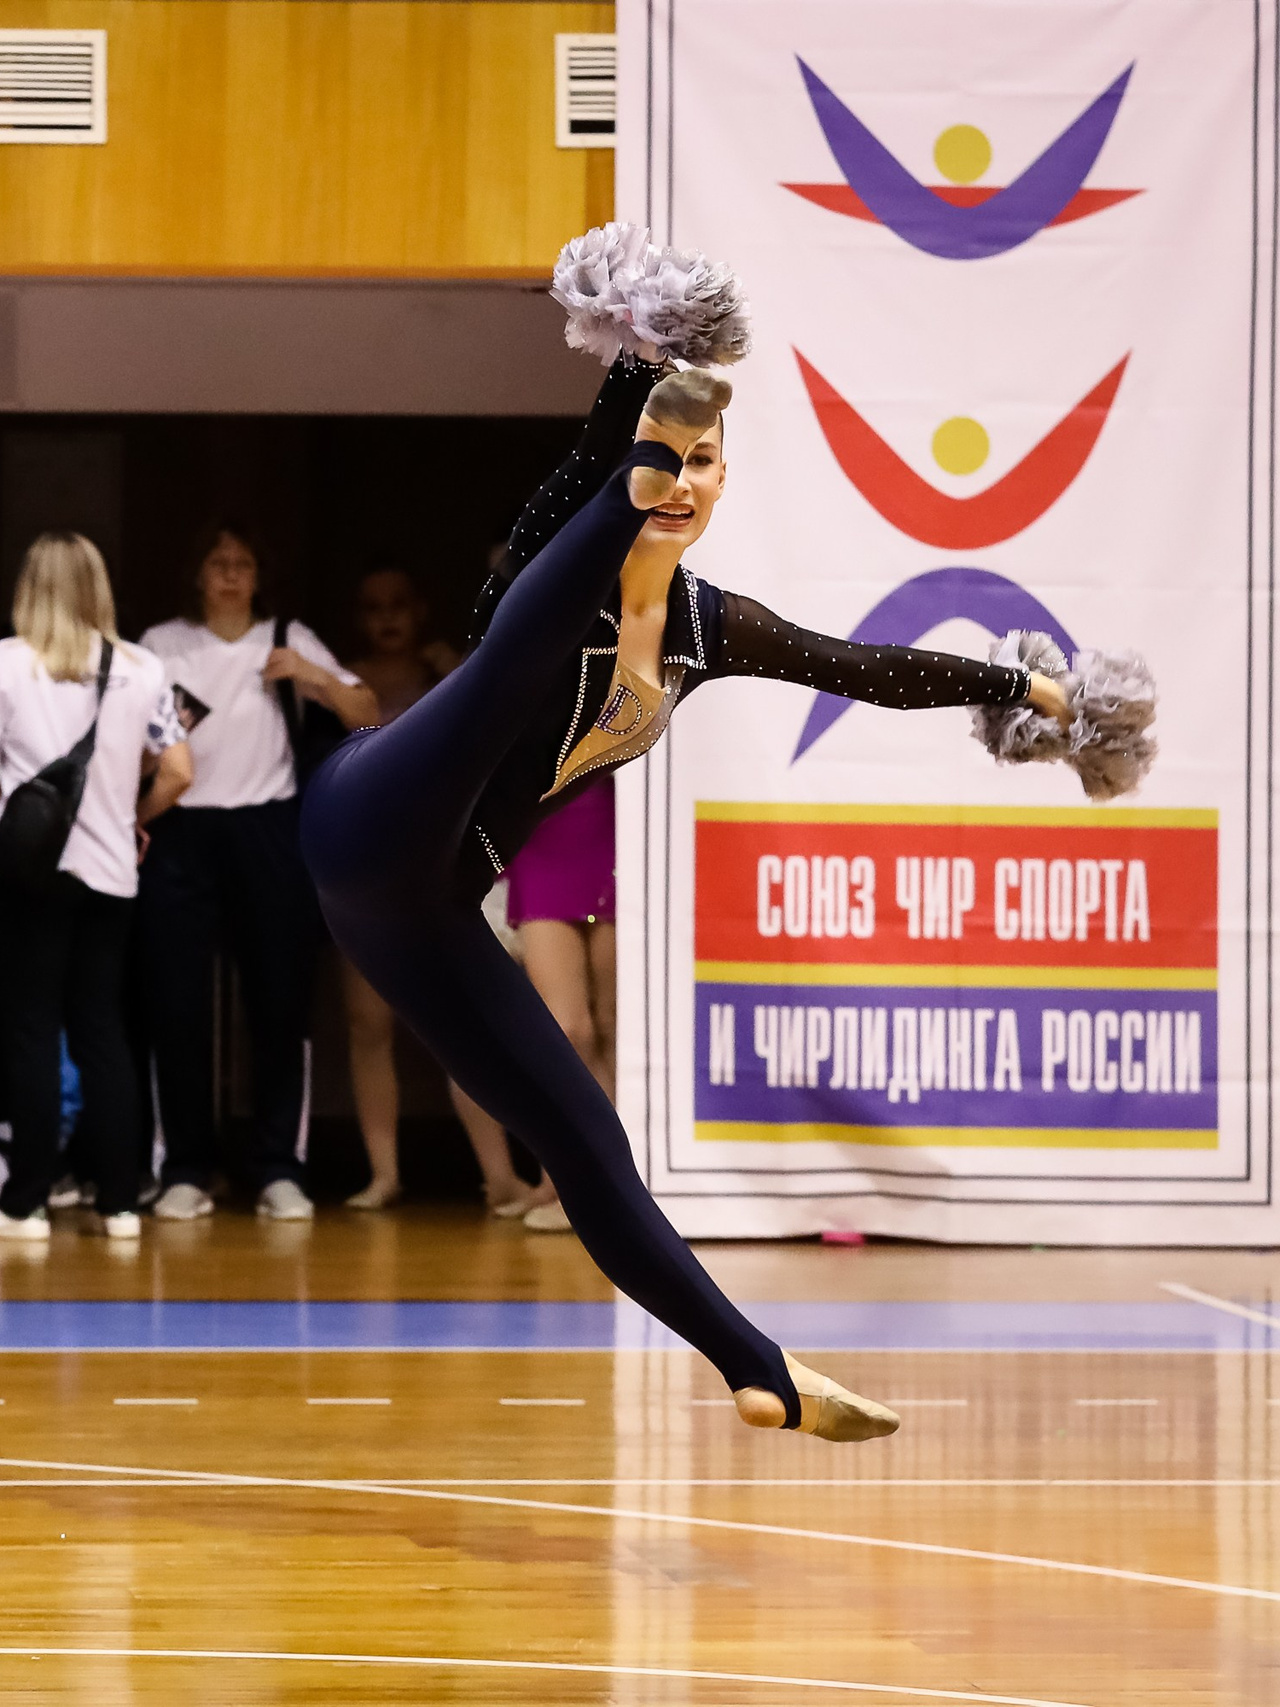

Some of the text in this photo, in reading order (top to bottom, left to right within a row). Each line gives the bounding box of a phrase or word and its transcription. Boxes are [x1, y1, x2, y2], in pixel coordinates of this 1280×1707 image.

[757, 855, 1151, 941] СОЮЗ ЧИР СПОРТА
[709, 1004, 1201, 1103] И ЧИРЛИДИНГА РОССИИ
